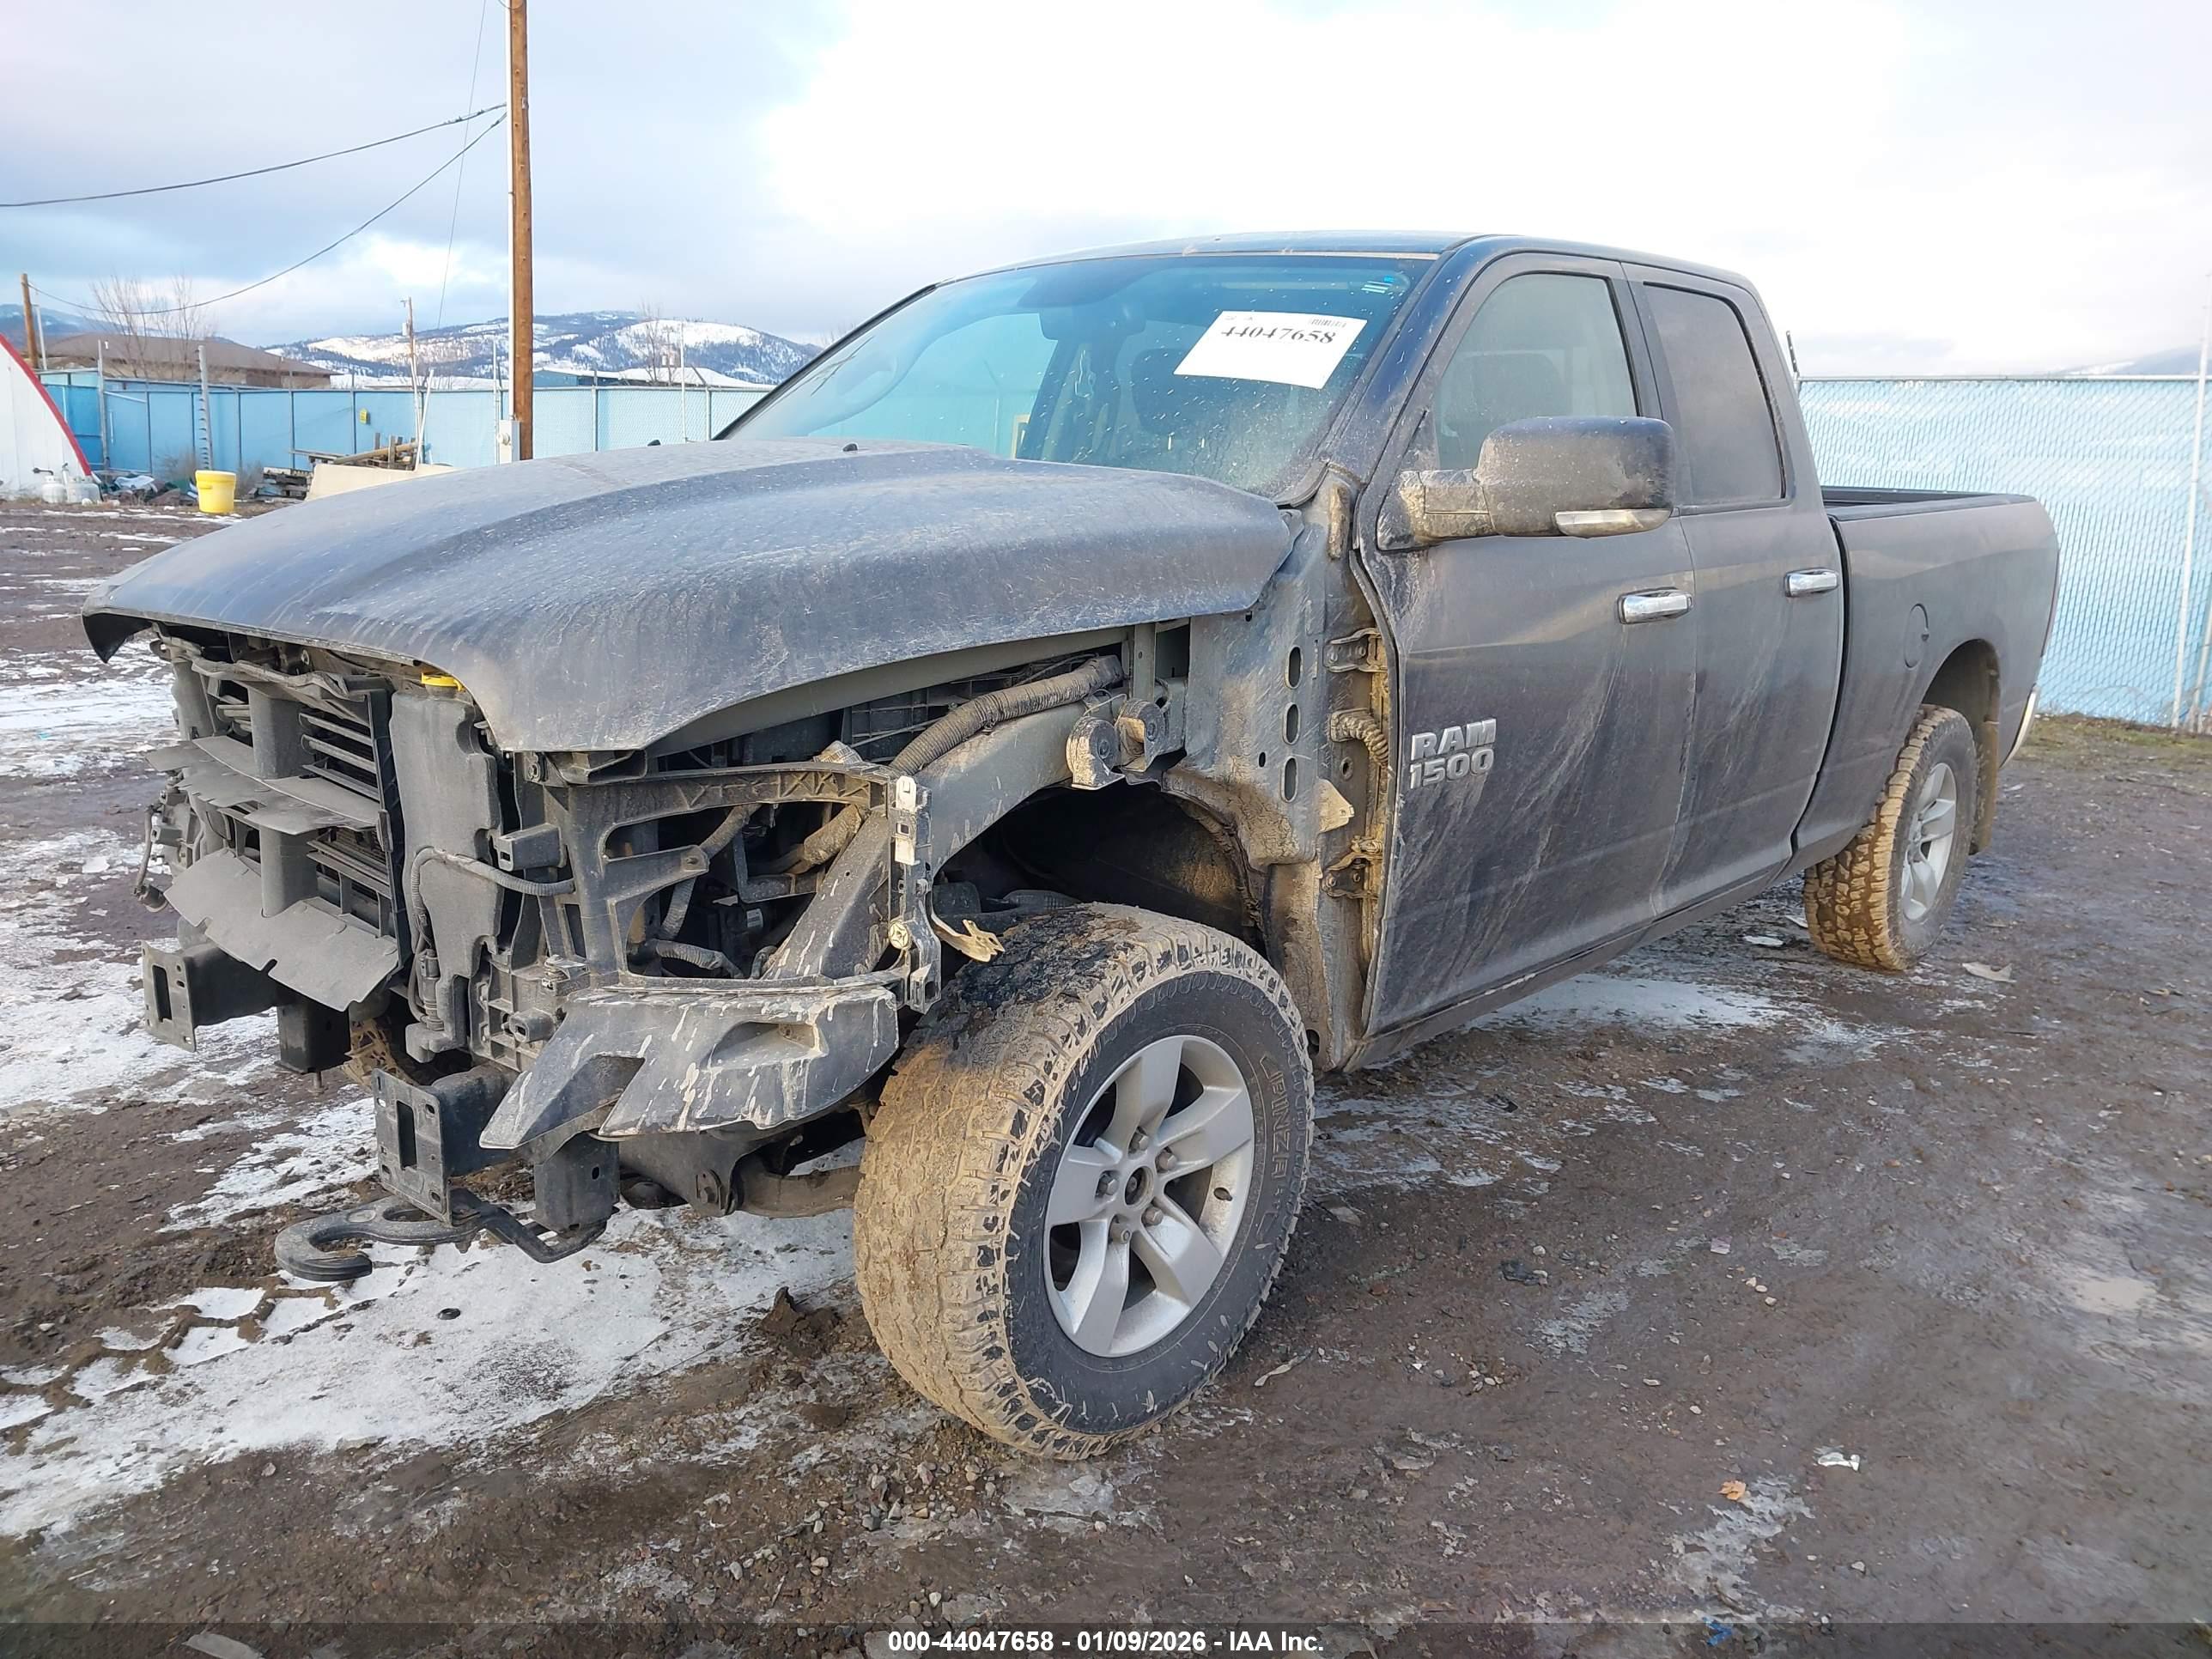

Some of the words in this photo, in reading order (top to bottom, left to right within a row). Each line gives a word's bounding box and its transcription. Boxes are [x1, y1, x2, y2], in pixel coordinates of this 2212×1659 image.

[1220, 325, 1336, 343] 44047658
[1410, 718, 1497, 762] RAM
[1409, 747, 1495, 789] 1500
